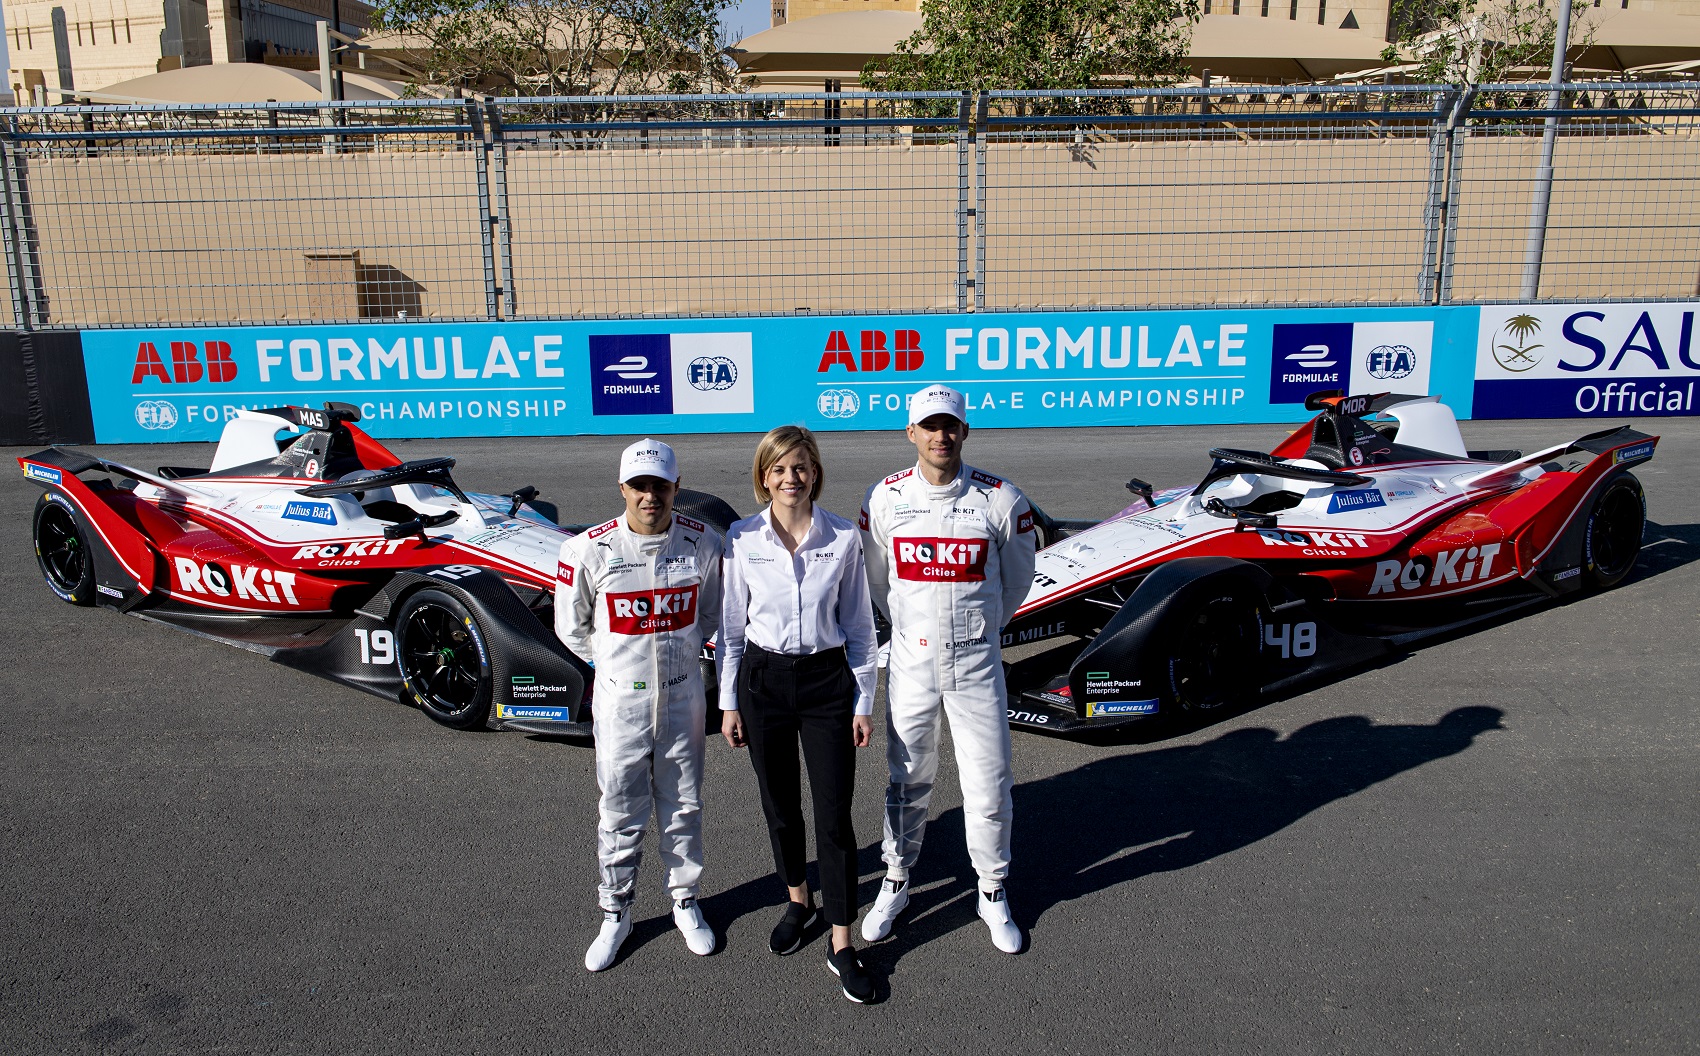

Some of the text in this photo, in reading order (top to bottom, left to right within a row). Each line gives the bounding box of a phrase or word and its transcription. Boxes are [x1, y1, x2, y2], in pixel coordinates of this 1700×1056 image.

[817, 324, 1248, 372] ABB FORMULA-E
[131, 335, 565, 384] ABB FORMULA-E
[1282, 373, 1338, 383] FORMULA-E
[604, 384, 660, 394] FORMULA-E
[869, 392, 1024, 411] FOLA-E
[1041, 388, 1245, 408] CHAMPIONSHIP
[1575, 382, 1694, 413] Official
[361, 399, 567, 420] CHAMPIONSHIP
[1341, 398, 1366, 415] MOR
[300, 410, 323, 427] MAS
[1352, 450, 1361, 463] E
[1624, 446, 1650, 458] MICHELIN
[34, 469, 59, 482] MICHELIN
[308, 462, 315, 475] E
[1335, 494, 1364, 508] Julius
[1364, 492, 1381, 504] Bär
[286, 504, 310, 517] Julius
[1302, 548, 1347, 556] Cities
[427, 565, 482, 580] 19
[922, 566, 956, 577] Cities
[640, 619, 672, 629] Cities
[1019, 621, 1065, 642] MILLE
[1265, 621, 1317, 658] 48
[354, 629, 394, 665] 19
[515, 709, 563, 717] MICHELIN
[1107, 704, 1154, 713] MICHELIN
